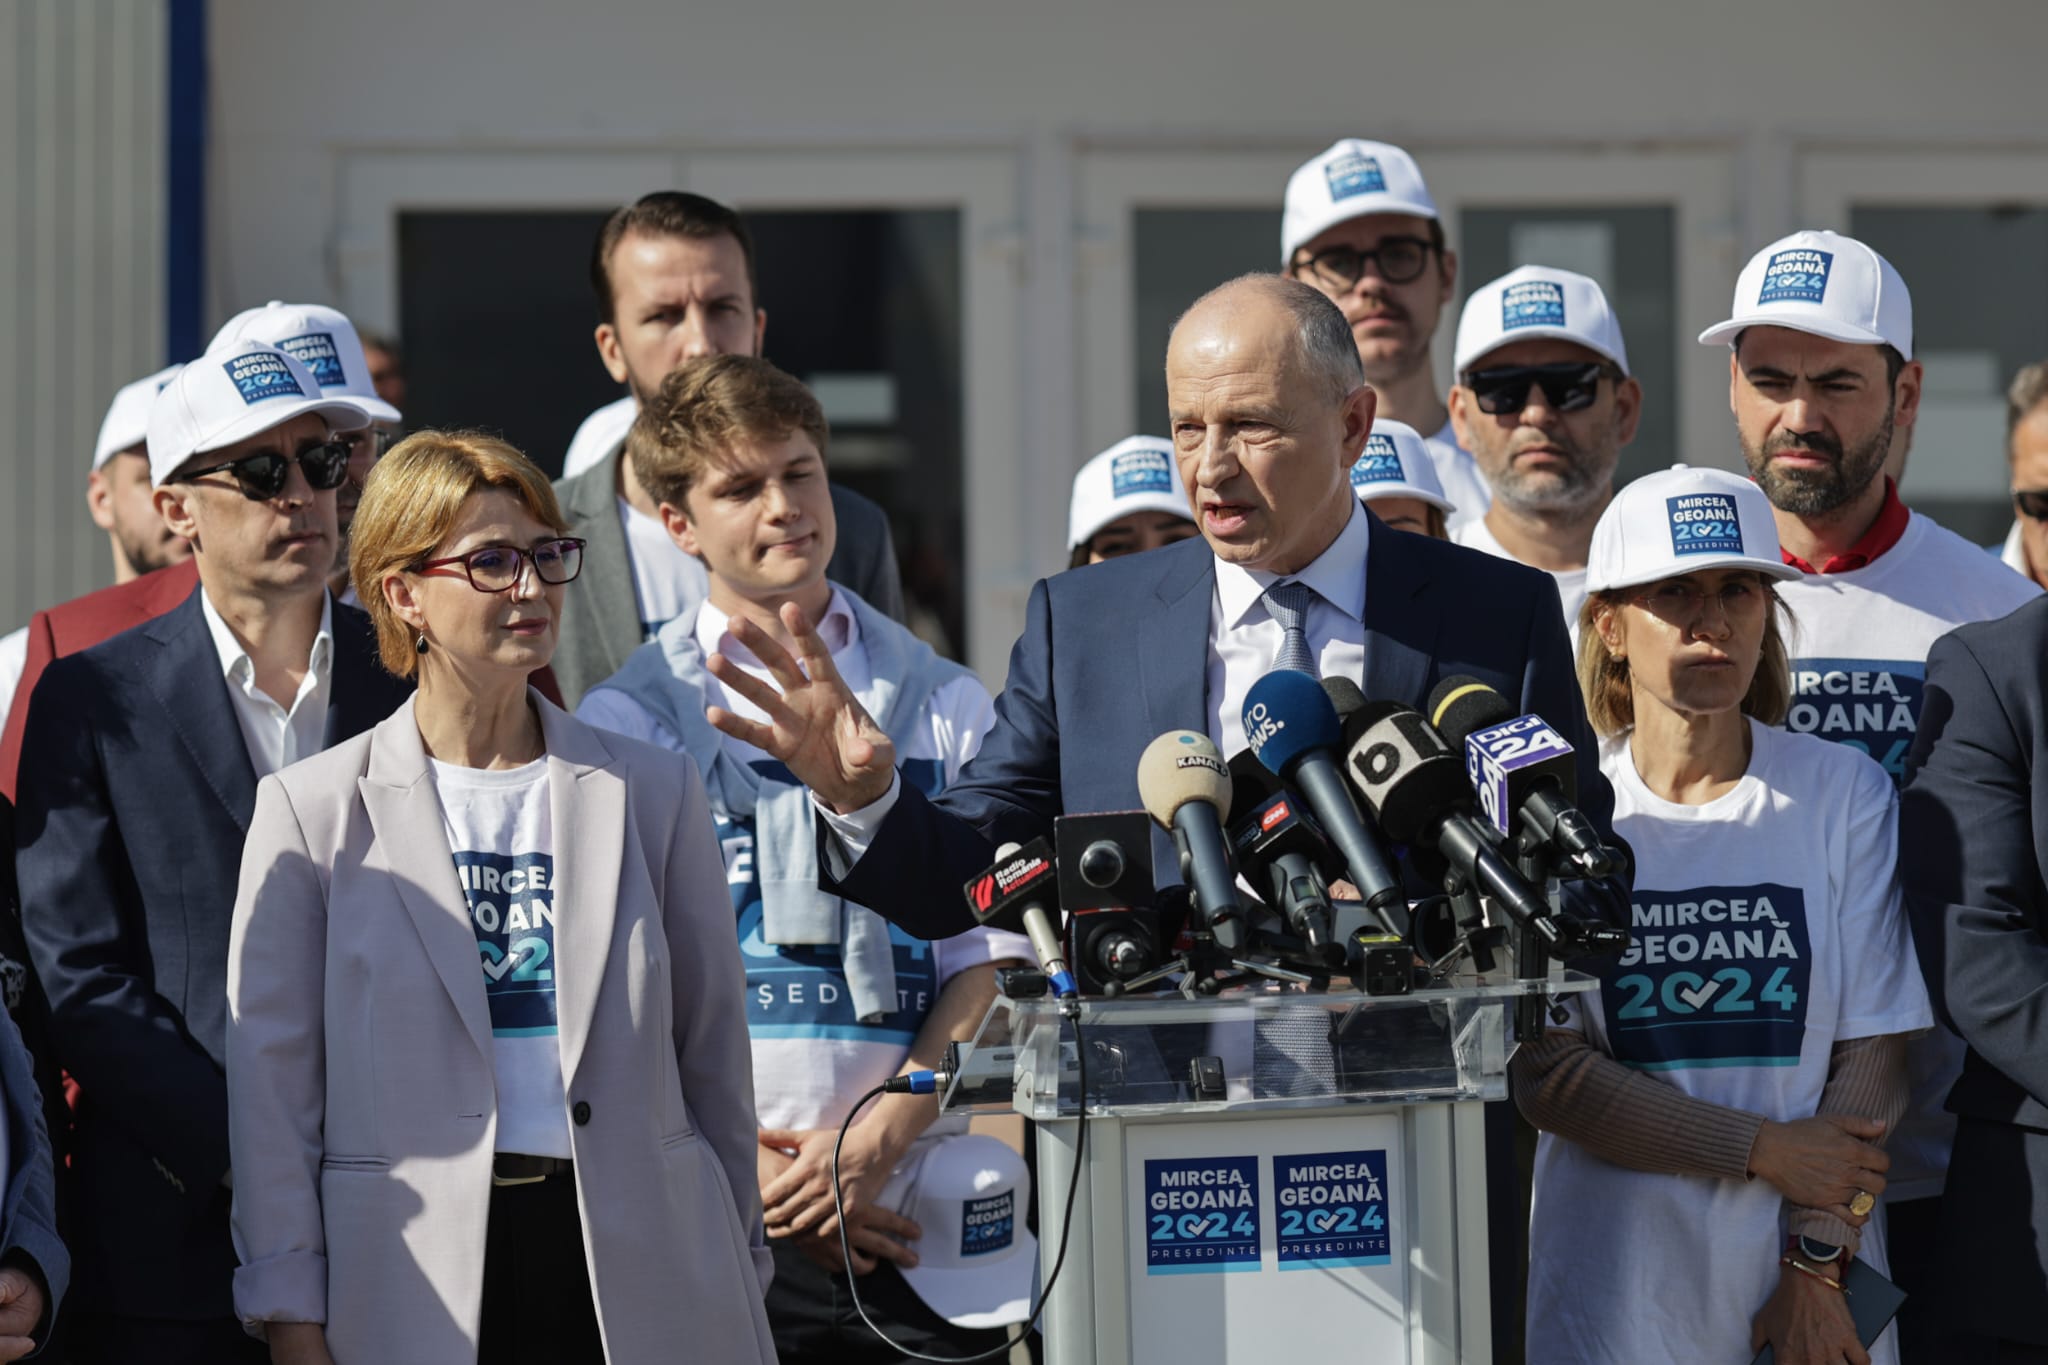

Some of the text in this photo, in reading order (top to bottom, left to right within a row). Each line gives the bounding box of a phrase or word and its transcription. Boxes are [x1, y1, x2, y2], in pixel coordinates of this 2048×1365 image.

[1775, 251, 1822, 264] MIRCEA
[1768, 262, 1826, 276] GEOANĂ
[1763, 273, 1823, 291] 2024
[233, 354, 279, 369] MIRCEA
[233, 361, 289, 380] GEOANĂ
[239, 372, 296, 393] 2024
[1677, 497, 1728, 509] MIRCEA
[1673, 506, 1736, 523] GEOANĂ
[1675, 521, 1739, 540] 2024
[1790, 670, 1899, 696] IRCEA
[1788, 695, 1917, 732] OANĂ
[1476, 717, 1542, 744] DIGI
[1488, 728, 1568, 764] 24
[1177, 757, 1219, 770] KANAL
[1480, 755, 1504, 831] 24
[1263, 807, 1285, 825] CNN
[457, 865, 554, 894] IRCE
[995, 858, 1026, 881] Radio
[1631, 896, 1778, 927] MIRCEA
[1618, 920, 1799, 967] GEOANĂ
[757, 983, 928, 1011] ȘEDTE
[1615, 966, 1798, 1020] 2024
[1161, 1169, 1244, 1187] MIRCEA
[1289, 1163, 1372, 1183] MIRCEA
[1150, 1184, 1254, 1210] GEOANĂ
[1280, 1177, 1383, 1206] GEOANĂ
[972, 1195, 1011, 1212] MIRCEA
[966, 1206, 1012, 1225] GEOANĂ
[1151, 1211, 1255, 1240] 2024
[1281, 1205, 1384, 1236] 2024
[965, 1217, 1012, 1242] 2024
[1151, 1246, 1256, 1259] PREȘEDINTE
[1281, 1240, 1385, 1255] PREȘEDINTE
